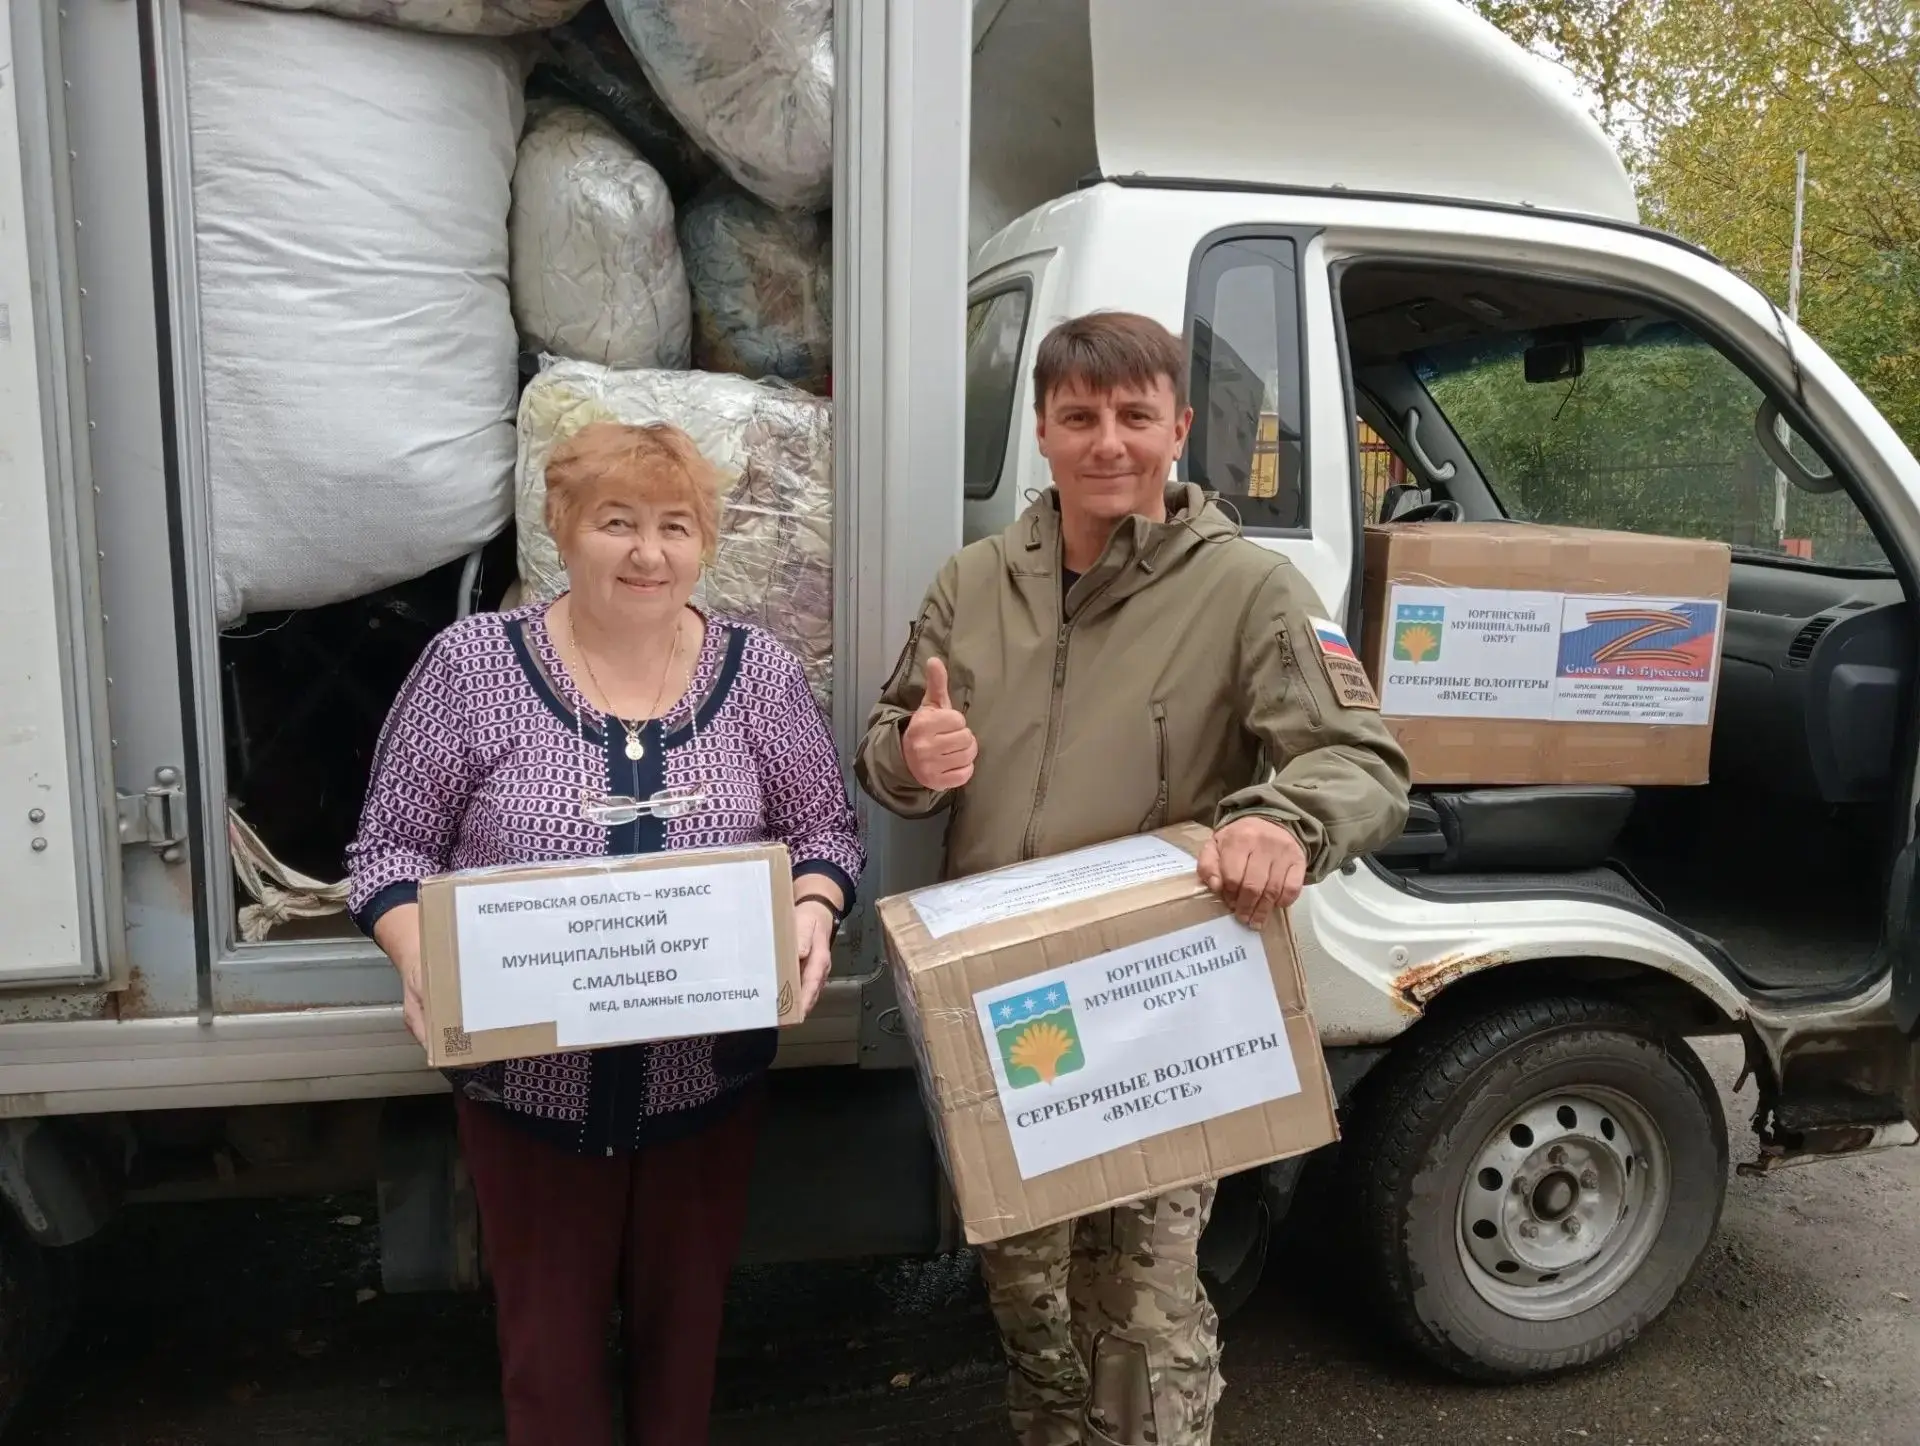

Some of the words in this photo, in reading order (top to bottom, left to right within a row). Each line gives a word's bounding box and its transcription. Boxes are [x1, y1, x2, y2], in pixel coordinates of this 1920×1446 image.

[1468, 608, 1536, 622] ЮРГИНСКИЙ
[1451, 620, 1550, 635] МУНИЦИПАЛЬНЫЙ
[1482, 633, 1516, 644] ОКРУГ
[1565, 663, 1610, 675] Своих
[1616, 664, 1634, 675] Не
[1640, 666, 1705, 678] Бросаем!
[1388, 674, 1471, 688] СЕРЕБРЯНЫЕ
[1473, 676, 1549, 690] ВОЛОНТЕРЫ
[1437, 688, 1498, 702] «ВМЕСТЕ»
[478, 896, 577, 915] КЕМЕРОВСКАЯ
[580, 890, 641, 906] ОБЛАСТЬ
[655, 884, 712, 900] КУЗБАСС
[568, 912, 668, 934] ЮРГИНСКИЙ
[501, 940, 656, 970] МУНИЦИПАЛЬНЫЙ
[660, 936, 709, 953] ОКРУГ
[1105, 935, 1218, 984] ЮРГИНСКИЙ
[572, 968, 678, 991] С.МАЛЬЦЕВО
[1084, 945, 1248, 1011] МУНИЦИПАЛЬНЫЙ
[623, 993, 684, 1009] ВЛАЖНЫЕ
[687, 987, 760, 1004] ПОЛОТЕНЦА
[1143, 983, 1200, 1012] ОКРУГ
[1015, 1072, 1151, 1129] СЕРЕБРЯНЫЕ
[1154, 1032, 1278, 1084] ВОЛОНТЕРЫ
[1102, 1082, 1203, 1124] «ВМЕСТЕ»
